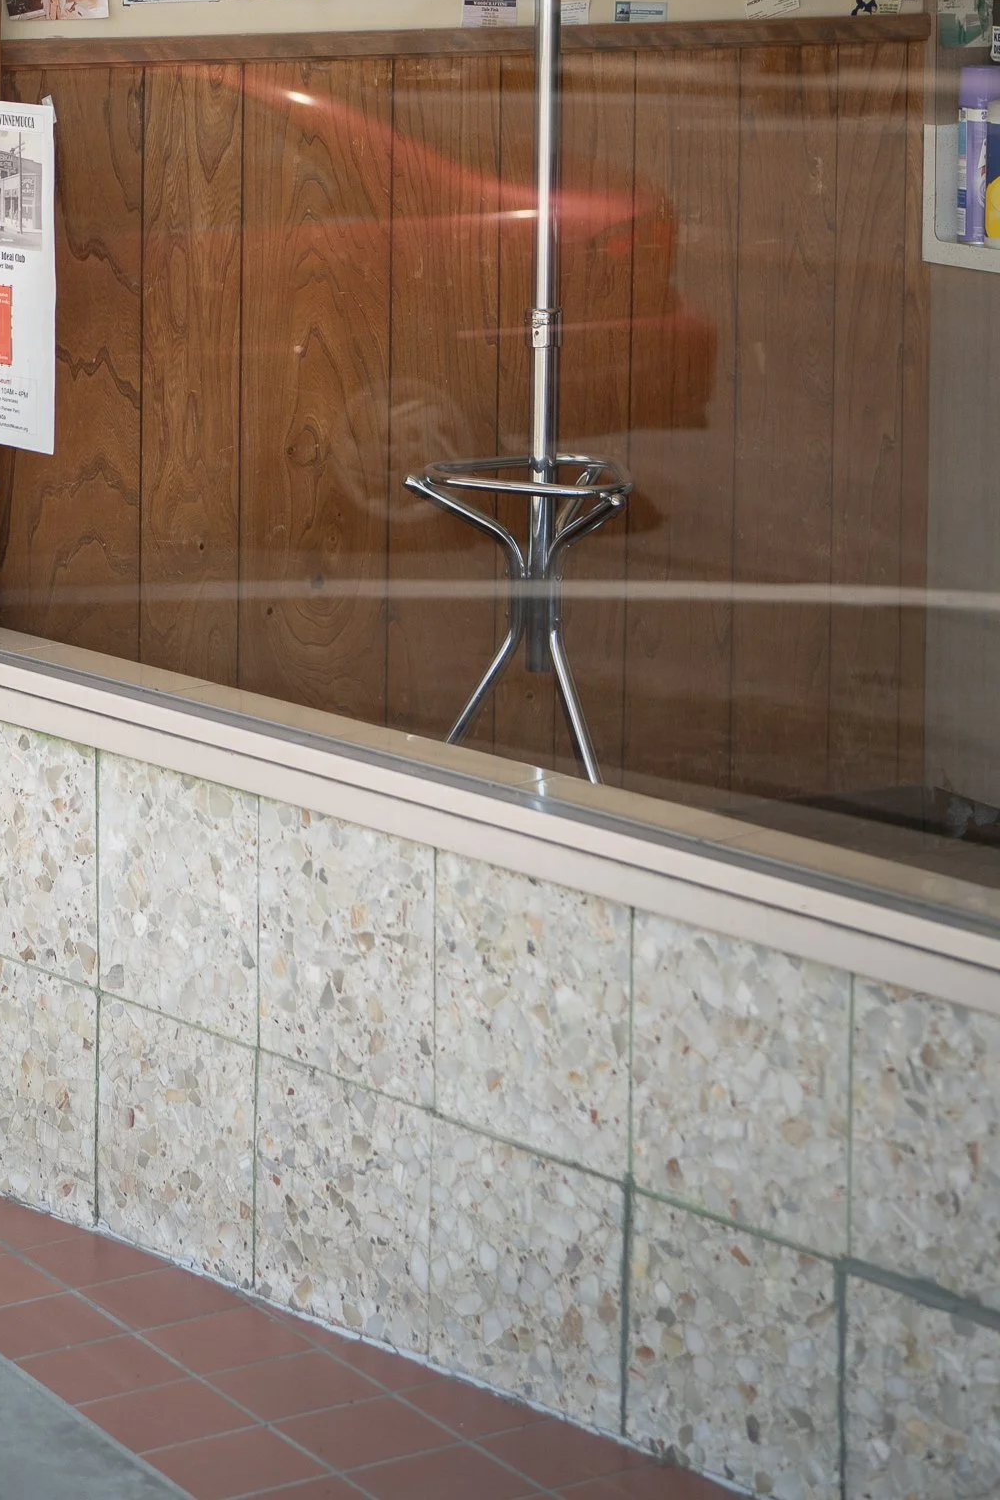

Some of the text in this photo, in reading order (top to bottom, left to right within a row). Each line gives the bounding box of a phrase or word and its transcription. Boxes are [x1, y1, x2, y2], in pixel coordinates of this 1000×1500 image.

[1, 251, 14, 261] Ideal
[14, 253, 26, 263] Club
[18, 389, 29, 398] 4PM
